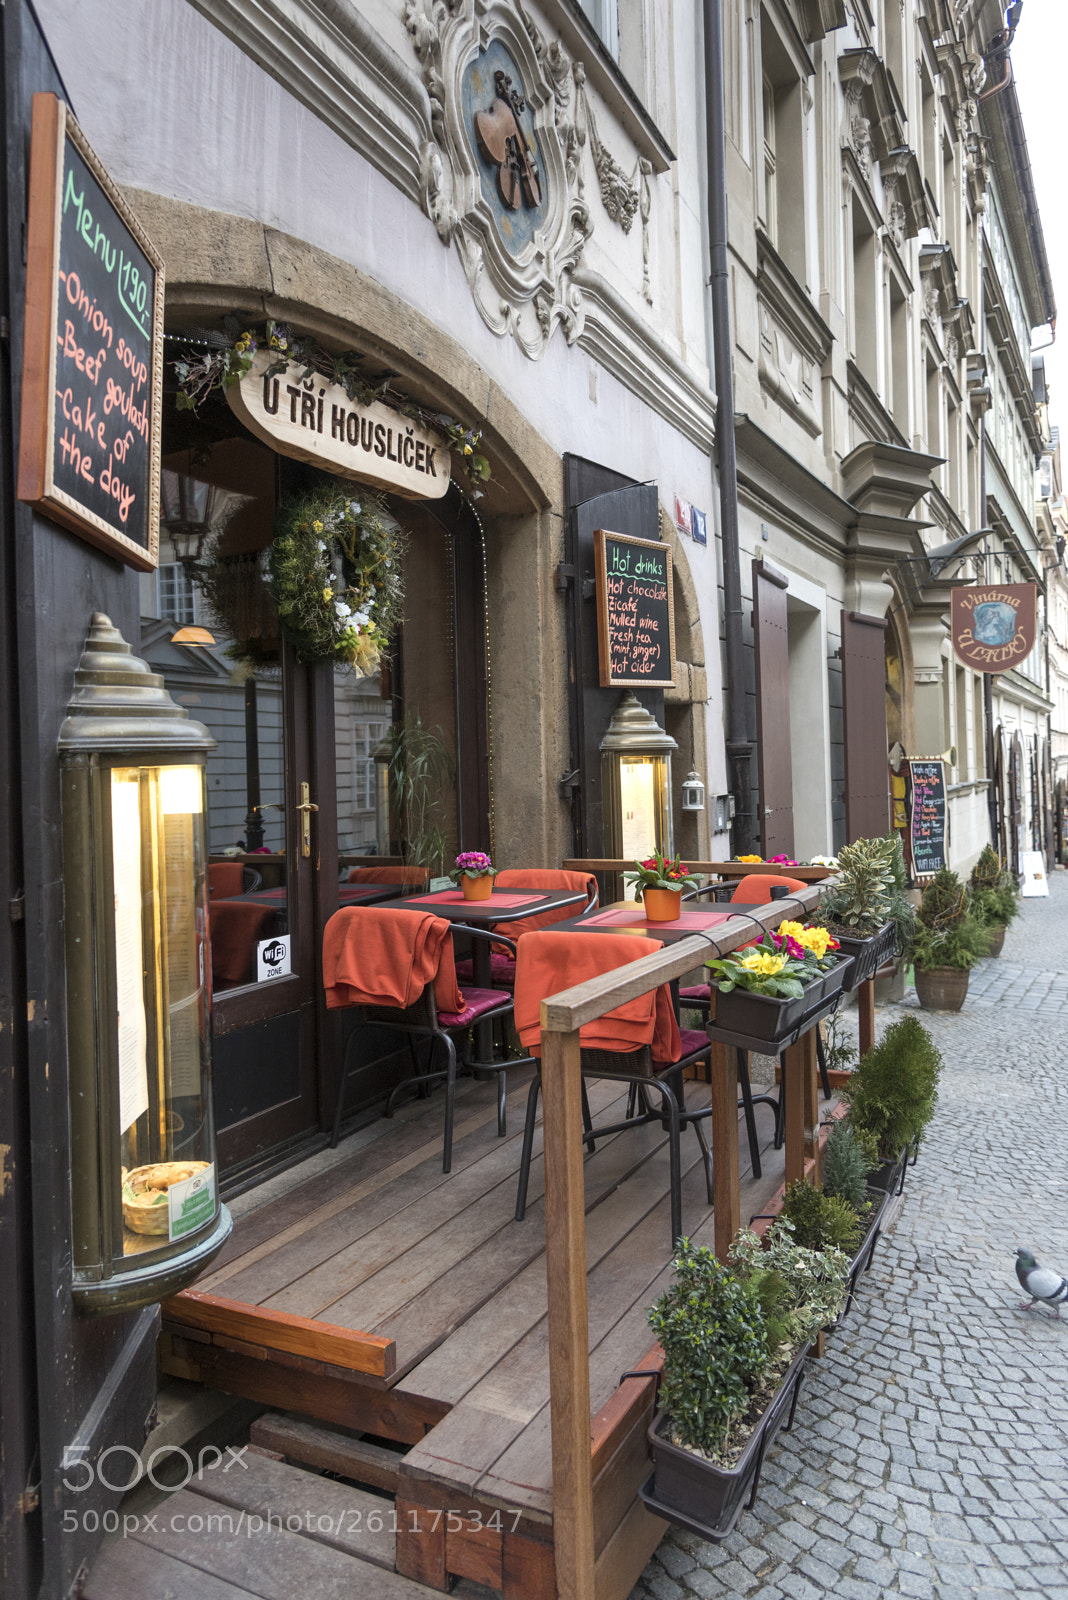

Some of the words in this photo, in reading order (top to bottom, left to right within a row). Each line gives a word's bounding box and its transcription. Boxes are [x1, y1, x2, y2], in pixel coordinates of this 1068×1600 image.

[63, 169, 117, 274] Menu
[115, 337, 148, 393] soup
[102, 376, 150, 445] goulash
[262, 376, 280, 416] U
[286, 377, 326, 435] TŘÍ
[331, 403, 438, 478] HOUSLIČEK
[113, 429, 135, 465] of
[58, 426, 96, 485] the
[99, 452, 137, 523] day
[612, 546, 632, 572] Hot
[634, 553, 663, 576] drinks
[607, 577, 625, 596] Hot
[960, 589, 1022, 611] Vinárna
[609, 611, 637, 628] Mulled
[639, 613, 660, 632] wine
[609, 626, 634, 643] Fresh
[635, 629, 653, 644] tea
[632, 642, 661, 662] ginger)
[610, 655, 629, 674] Hot
[630, 659, 656, 674] cider
[928, 856, 942, 870] FREE
[267, 967, 283, 977] ZONE
